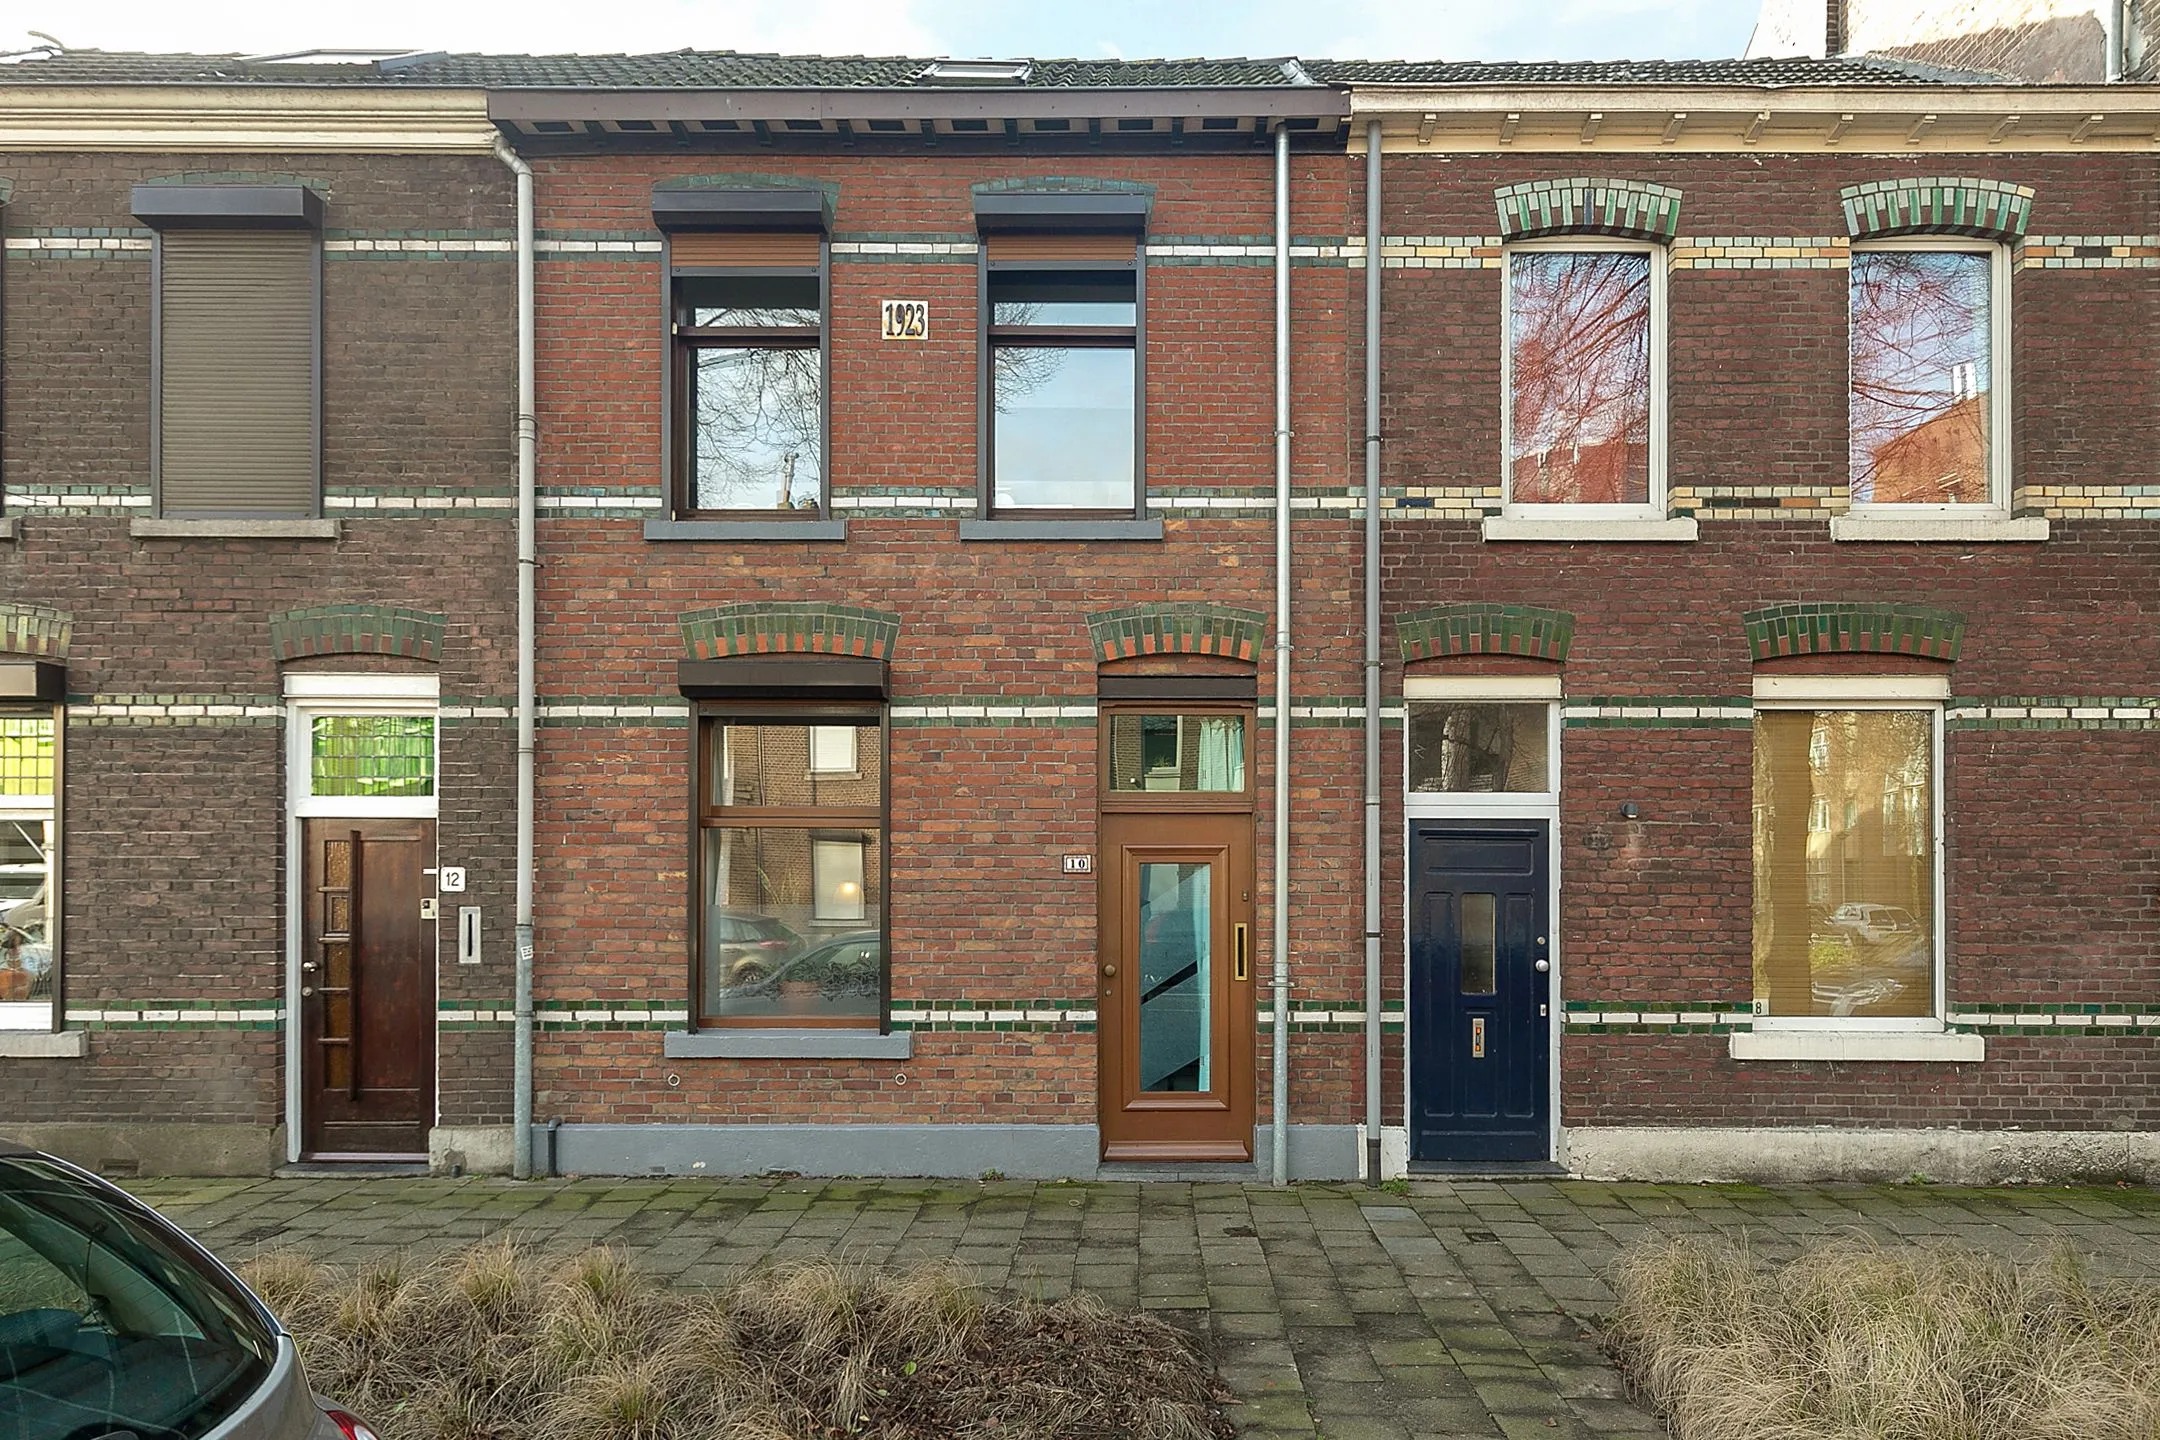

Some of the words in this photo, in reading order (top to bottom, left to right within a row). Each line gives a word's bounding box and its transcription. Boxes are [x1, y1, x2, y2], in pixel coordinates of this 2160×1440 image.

[885, 303, 925, 336] 1923
[1071, 859, 1085, 868] 10
[446, 872, 459, 886] 12
[1755, 1001, 1761, 1014] 8
